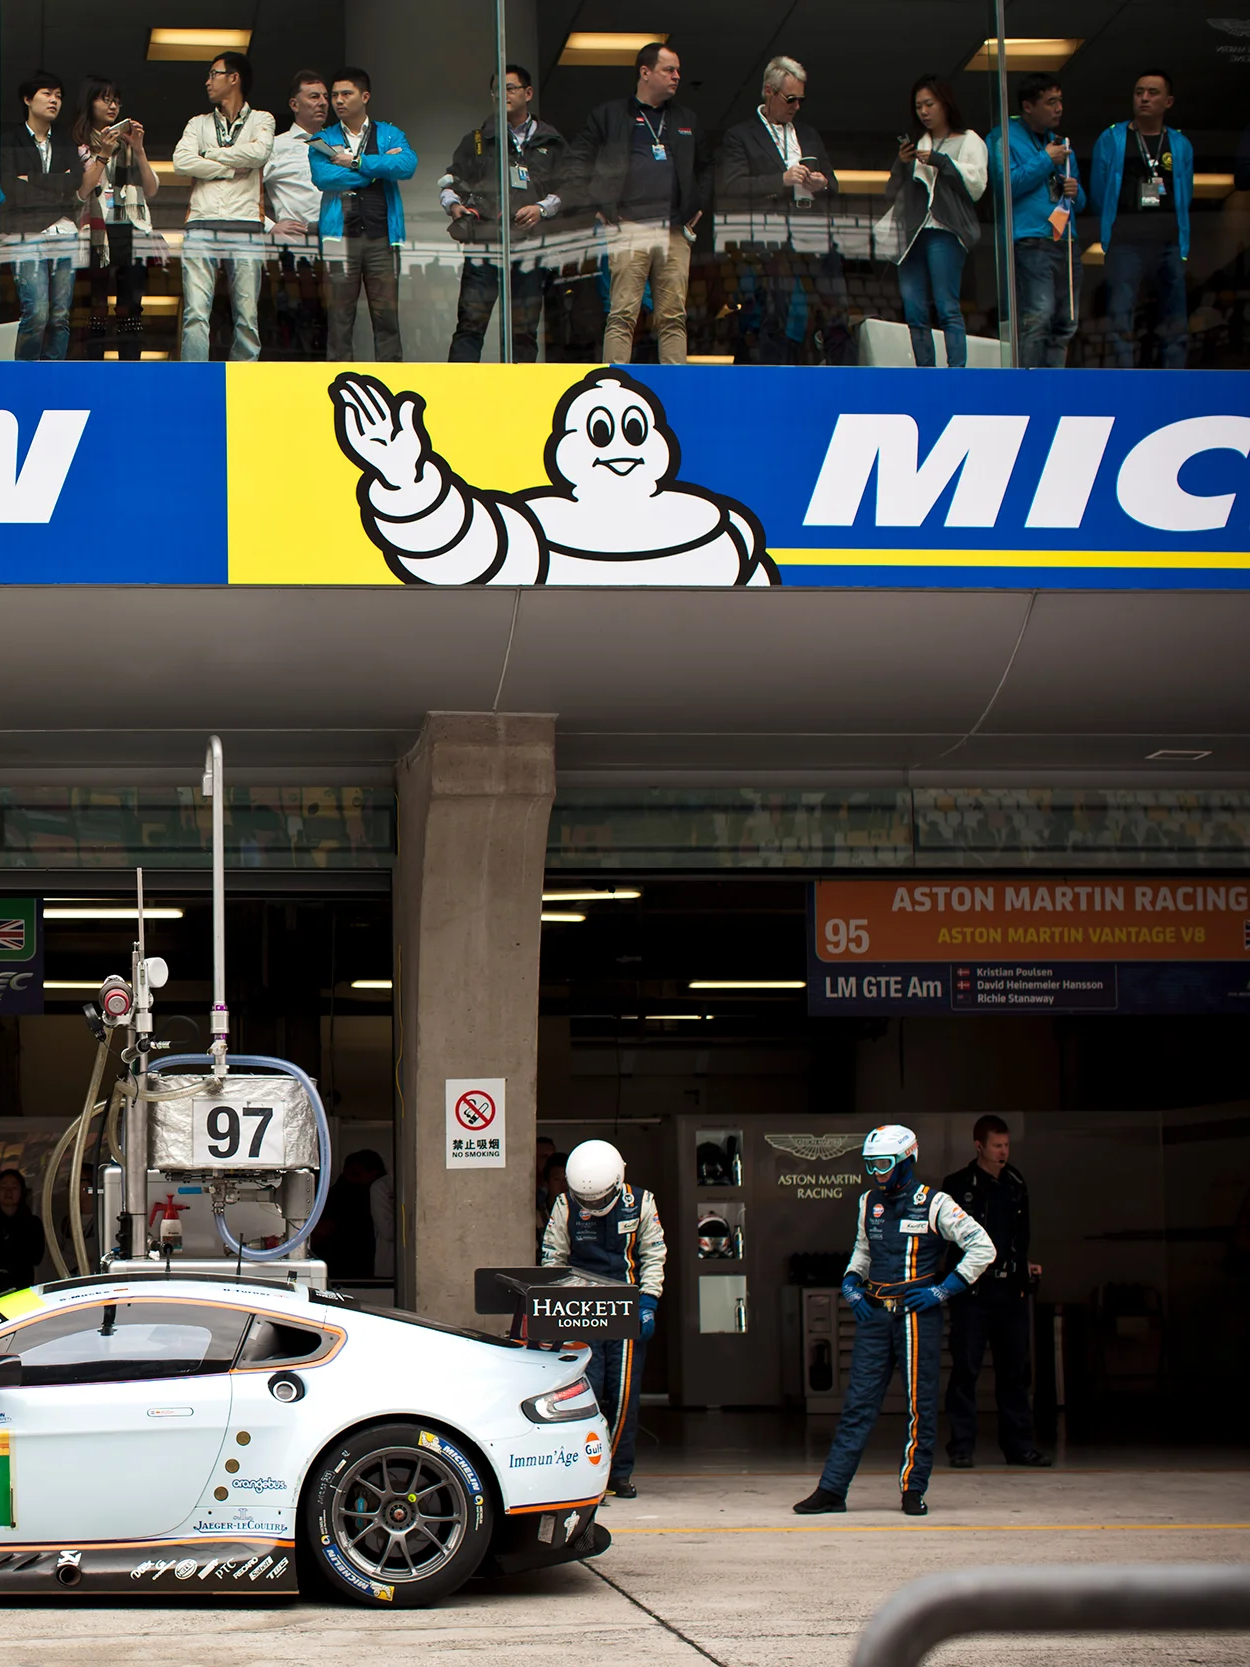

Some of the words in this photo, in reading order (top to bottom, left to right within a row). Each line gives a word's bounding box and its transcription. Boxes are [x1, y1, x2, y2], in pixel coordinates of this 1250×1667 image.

[891, 887, 994, 912] ASTON
[1005, 887, 1124, 912] MARTIN
[1135, 887, 1248, 912] RACING
[825, 918, 870, 954] 95
[937, 927, 1002, 943] ASTON
[1008, 927, 1083, 943] MARTIN
[1088, 927, 1177, 943] VANTAGE
[1181, 927, 1206, 943] V8
[976, 968, 1013, 977] Kristian
[1016, 968, 1053, 977] Poulsen
[825, 976, 857, 998] LM
[863, 976, 902, 998] GTE
[907, 976, 942, 998] Am
[977, 980, 1005, 990] David
[1007, 980, 1061, 990] Heinemeier
[1063, 980, 1104, 990] Hansson
[978, 994, 1006, 1003] Richie
[1008, 994, 1054, 1005] Stanaway
[206, 1106, 274, 1159] 97
[453, 1139, 500, 1150] 禁止吸烟
[777, 1174, 816, 1185] ASTON
[818, 1174, 862, 1185] MARTIN
[797, 1188, 843, 1199] RACING
[533, 1299, 634, 1317] HACKETT
[558, 1319, 608, 1328] LONDON
[442, 1445, 481, 1492] MICHELIN
[215, 1558, 237, 1580] PTC
[232, 1556, 259, 1580] RECARO
[326, 1549, 370, 1590] MICHELIN
